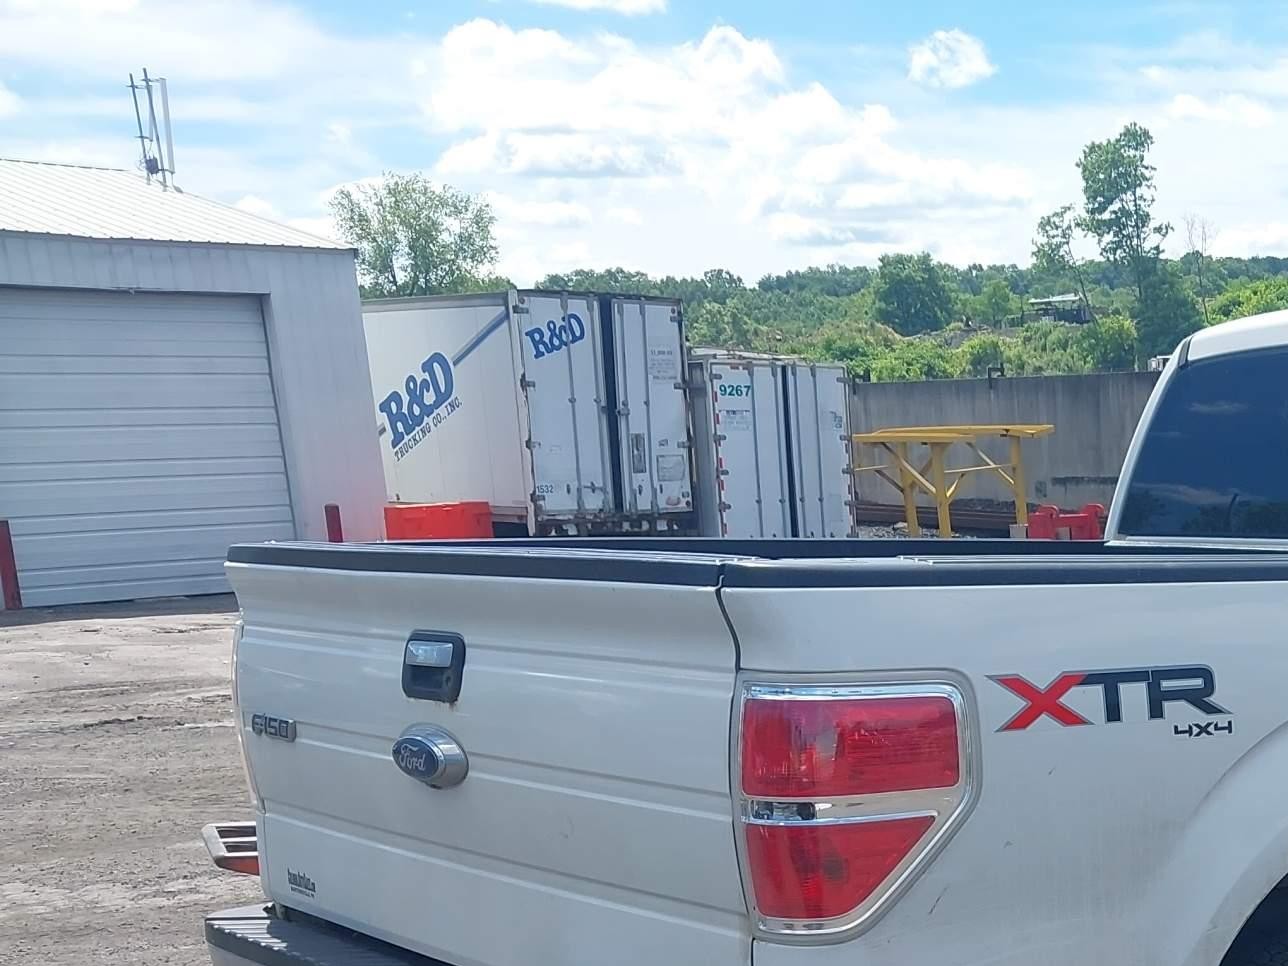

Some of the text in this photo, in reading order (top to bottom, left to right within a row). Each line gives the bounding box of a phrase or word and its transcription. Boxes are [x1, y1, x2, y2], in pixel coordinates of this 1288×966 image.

[525, 312, 585, 360] R&D
[379, 352, 454, 449] R&D
[718, 383, 752, 398] 9267
[394, 422, 432, 462] TRUCKING
[446, 396, 463, 416] INC.
[536, 484, 554, 494] 1532
[984, 663, 1233, 733] XTR
[398, 742, 427, 772] Ford
